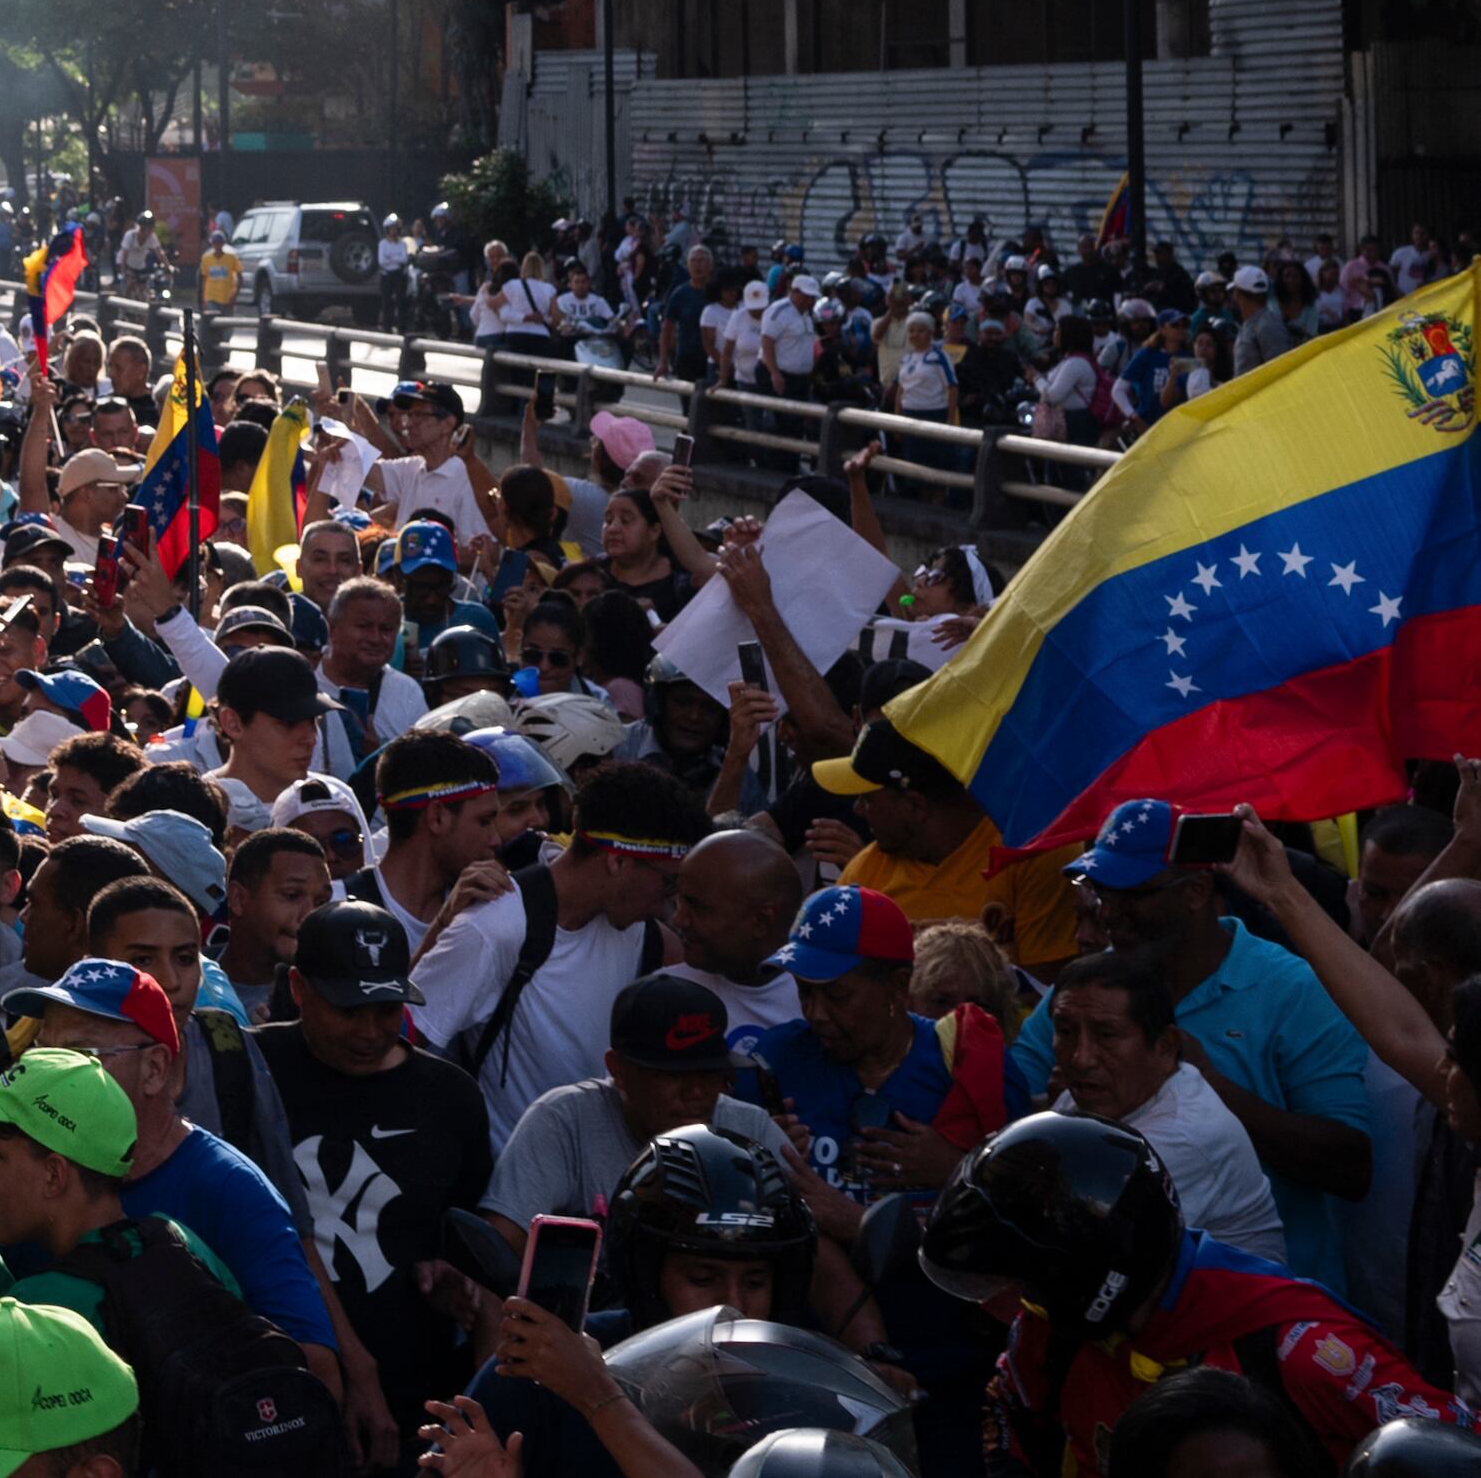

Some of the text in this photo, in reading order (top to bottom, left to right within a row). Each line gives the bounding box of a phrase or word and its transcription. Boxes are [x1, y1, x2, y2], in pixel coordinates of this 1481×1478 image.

[613, 841, 670, 855] Presidente
[292, 1134, 403, 1293] NY
[696, 1212, 775, 1228] LS2
[1084, 1270, 1130, 1323] EDGE
[244, 1416, 306, 1442] VICTORINOX
